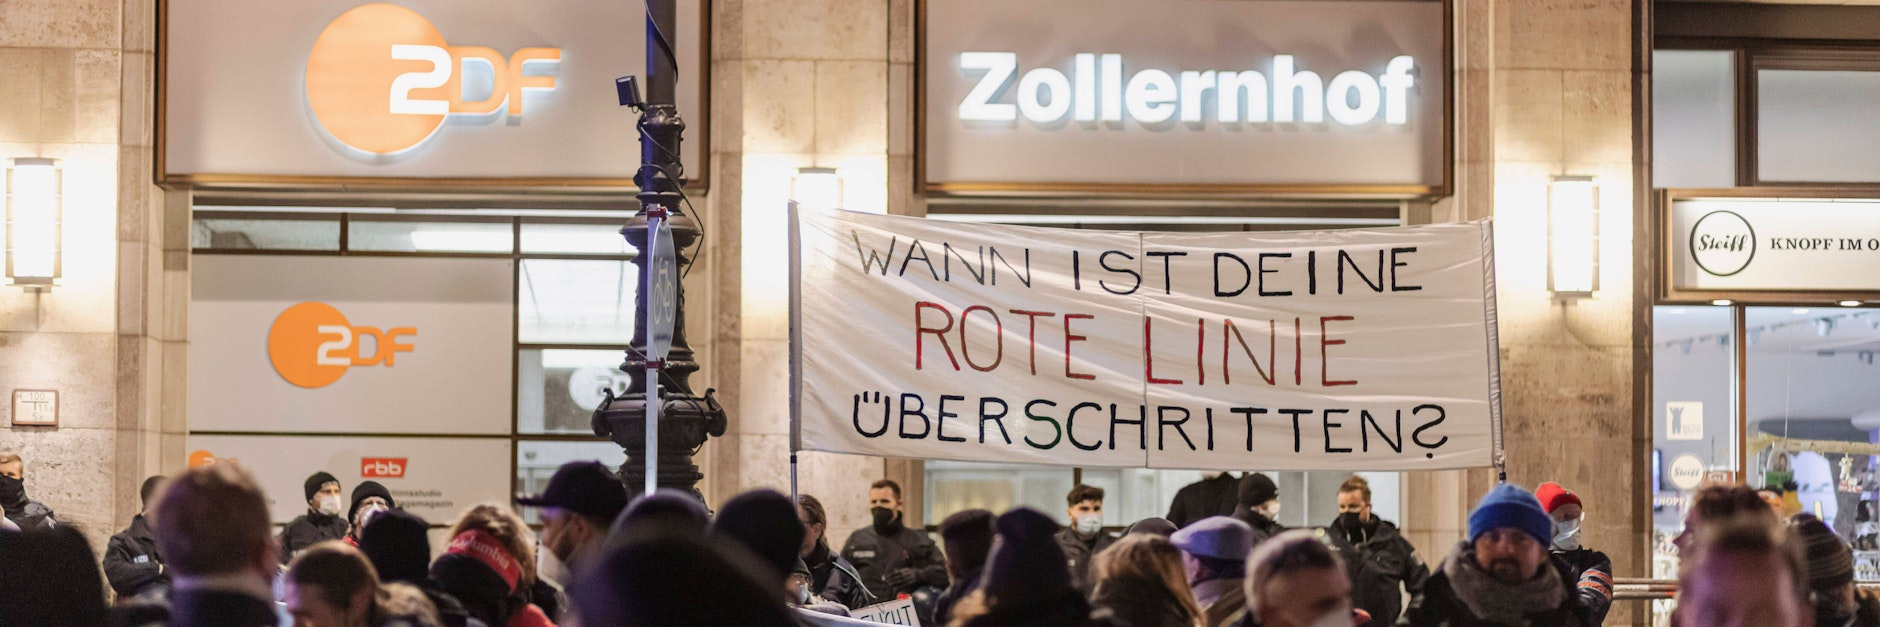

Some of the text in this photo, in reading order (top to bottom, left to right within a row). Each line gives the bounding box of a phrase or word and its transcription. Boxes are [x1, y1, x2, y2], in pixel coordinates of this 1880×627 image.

[958, 51, 1414, 126] Zollernhof
[851, 228, 1423, 298] WANN IST DEINE
[1698, 234, 1748, 253] Steiff
[1770, 238, 1834, 251] KNOPF
[1838, 238, 1863, 251] IM
[915, 301, 1359, 387] ROTE LINIE
[852, 390, 1449, 459] ÜBERSCHRITTEN?
[363, 460, 402, 476] rbb
